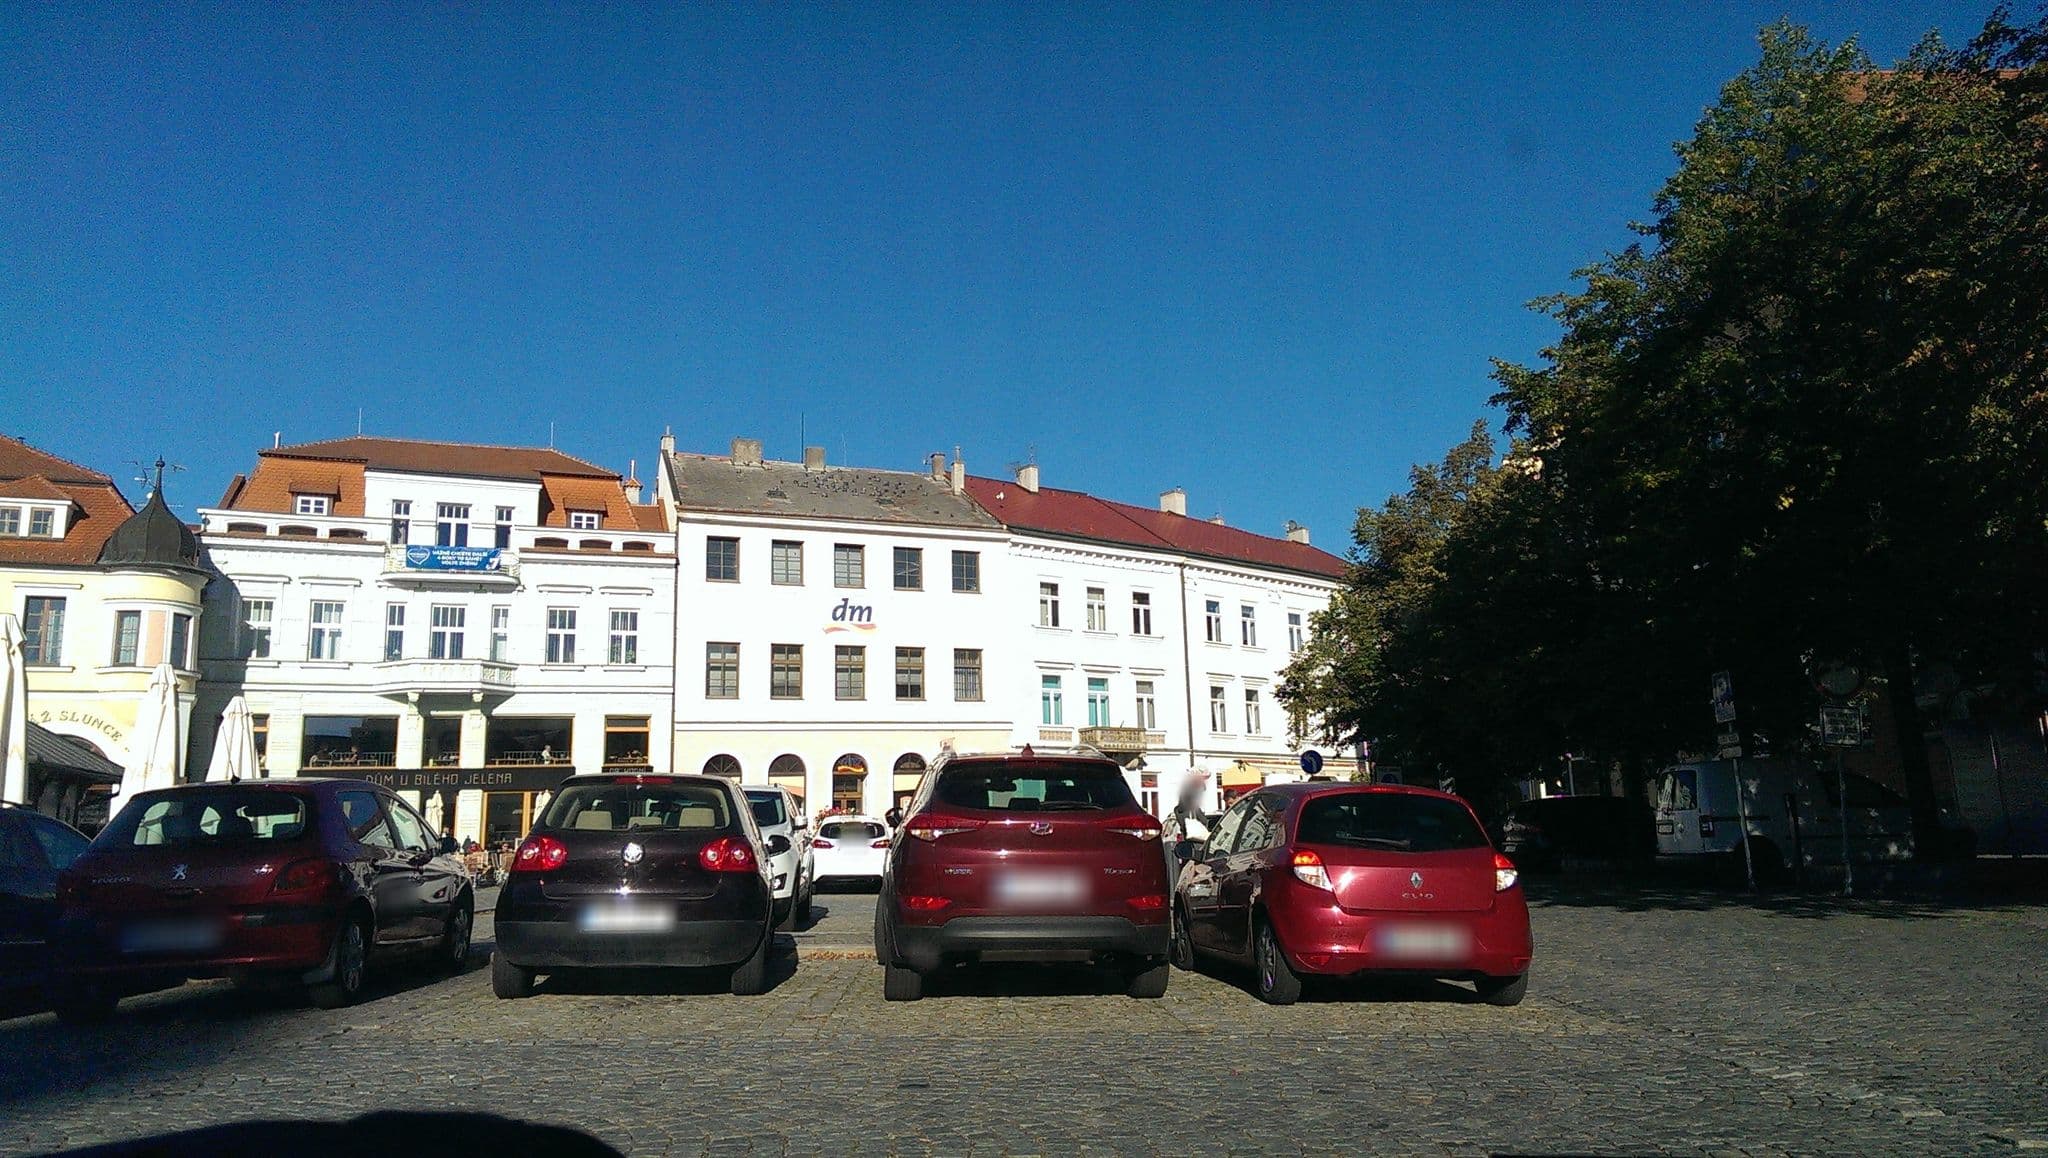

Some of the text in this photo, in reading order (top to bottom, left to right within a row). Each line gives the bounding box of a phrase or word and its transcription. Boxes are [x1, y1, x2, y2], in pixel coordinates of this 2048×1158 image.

[832, 598, 872, 622] dm
[59, 710, 122, 742] SLUNCE
[366, 772, 395, 786] DŮM
[401, 774, 409, 786] U
[464, 772, 513, 785] JELENA
